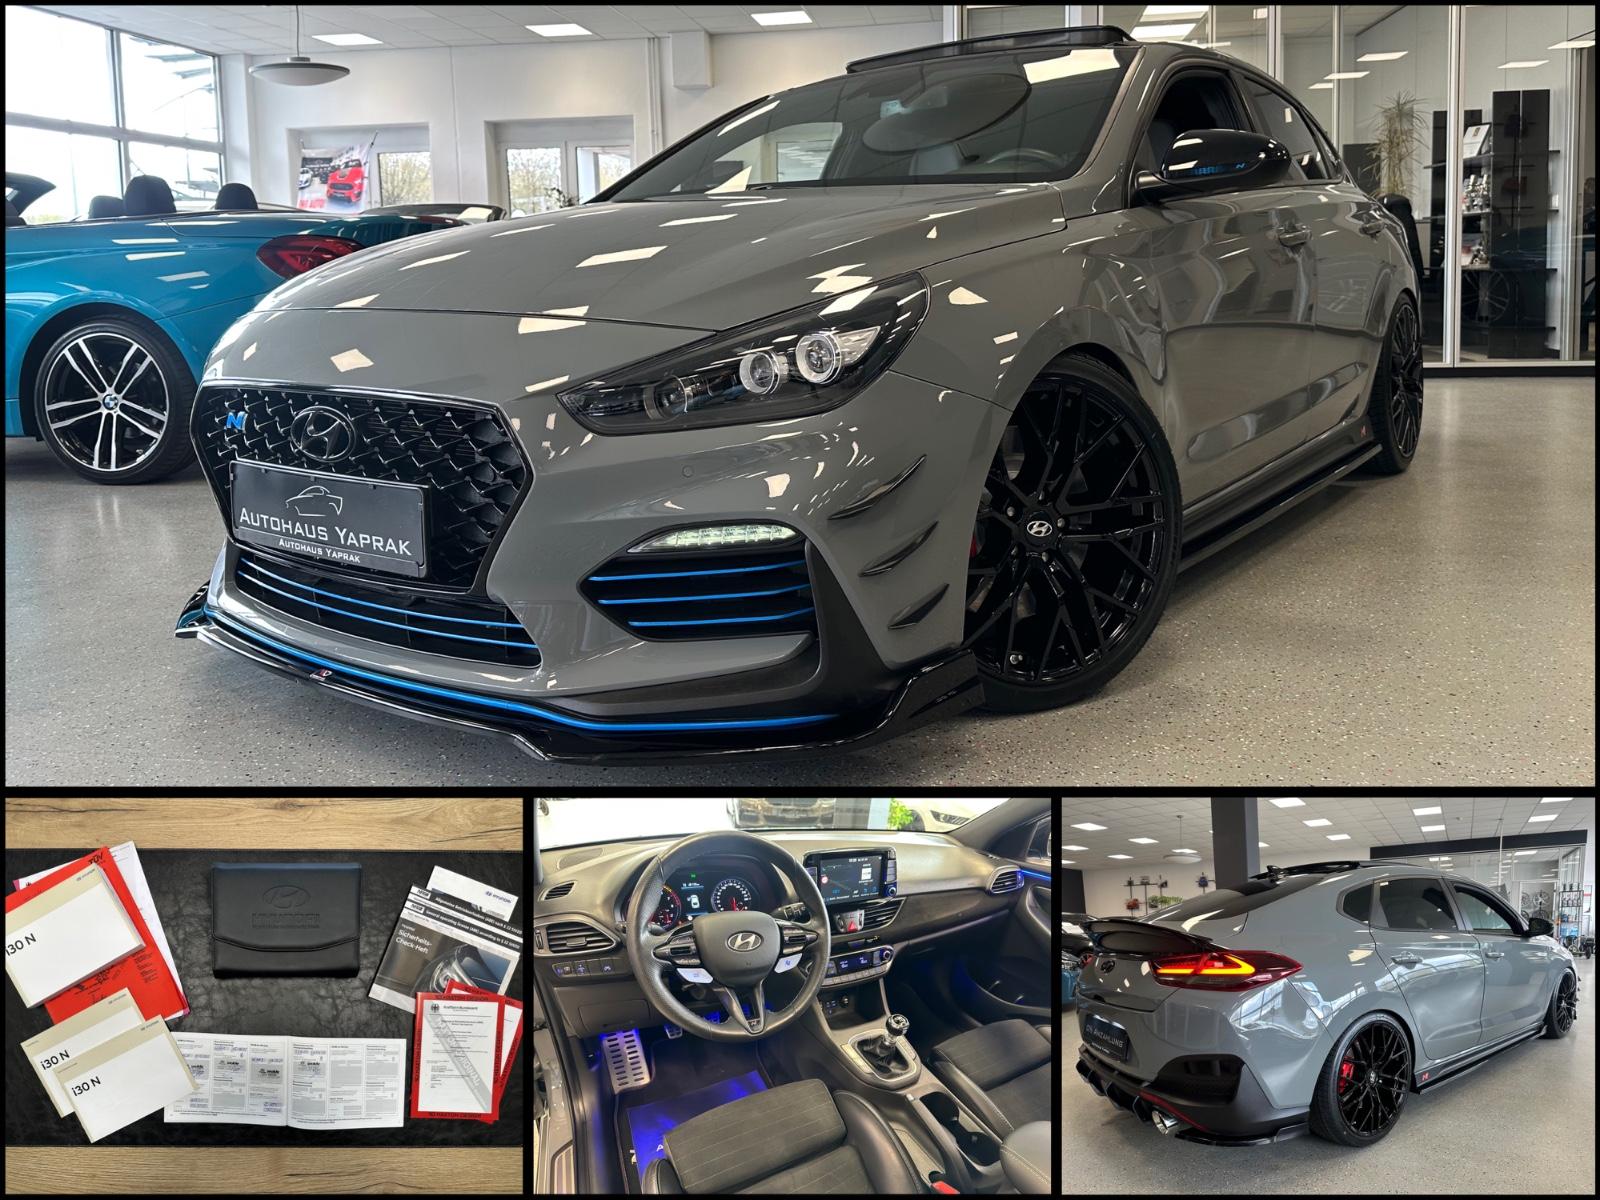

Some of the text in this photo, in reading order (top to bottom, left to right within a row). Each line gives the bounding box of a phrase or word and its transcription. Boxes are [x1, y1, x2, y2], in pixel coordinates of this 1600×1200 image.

[226, 411, 248, 432] N
[239, 507, 412, 556] AUTOHAUS YAPRAK
[279, 538, 361, 563] AUTOHAUS YAPRAK
[25, 932, 37, 946] N
[40, 1055, 59, 1070] i30
[59, 1049, 70, 1061] N
[72, 1075, 101, 1096] i30 N
